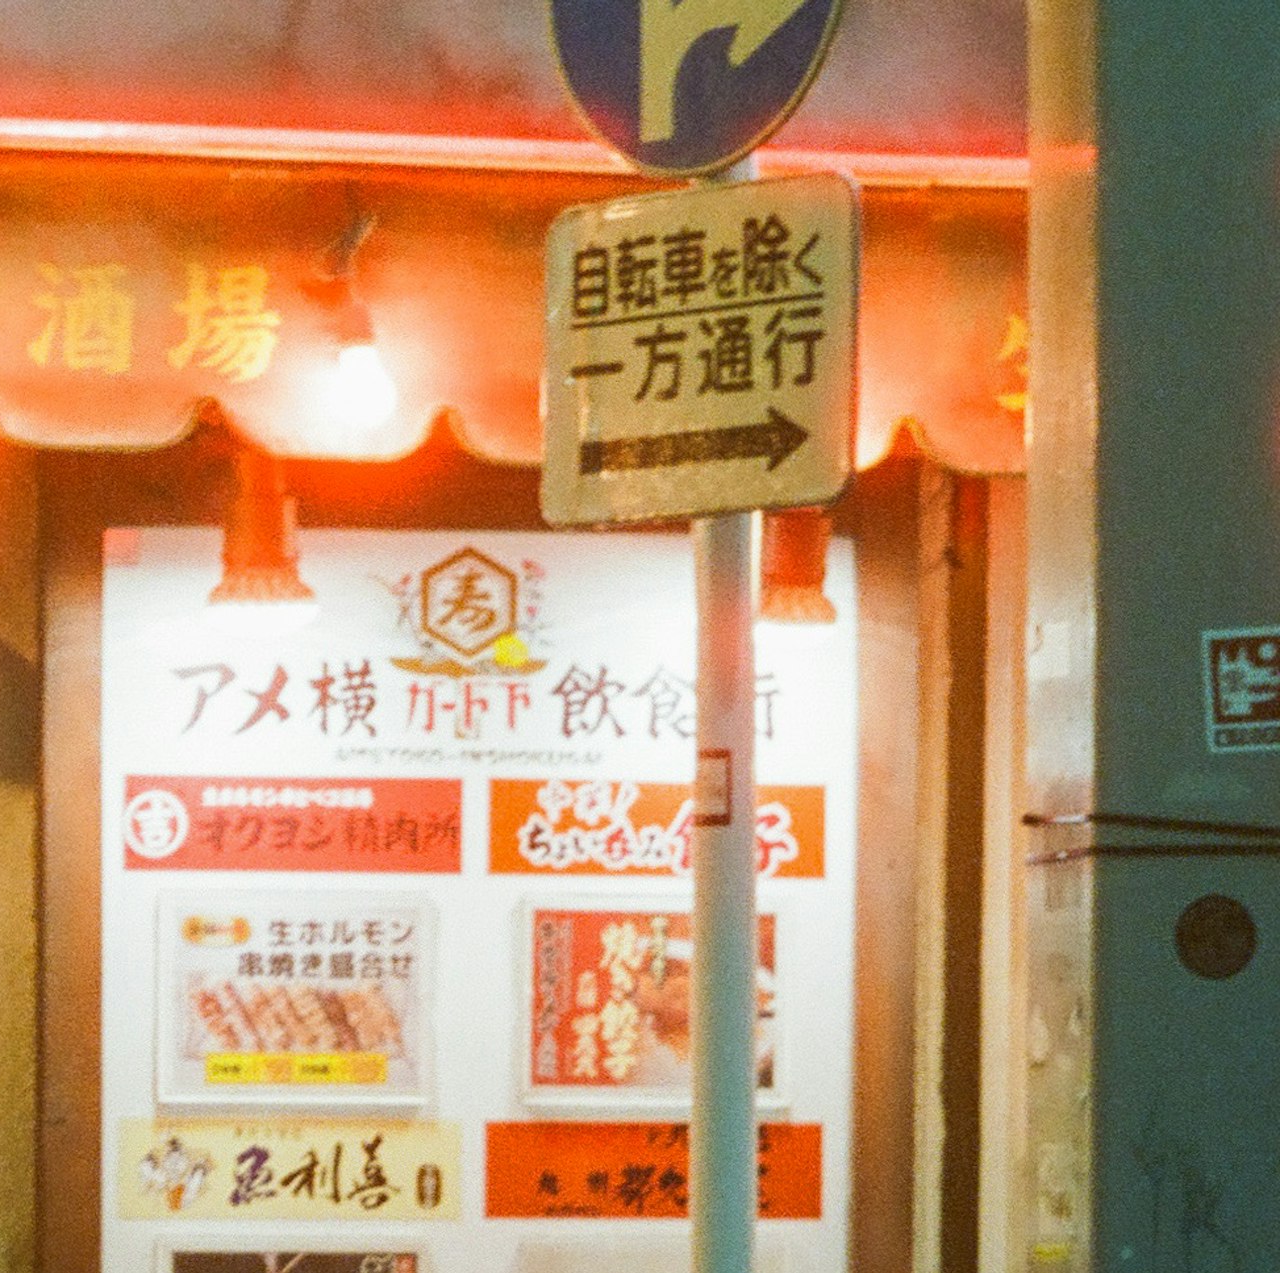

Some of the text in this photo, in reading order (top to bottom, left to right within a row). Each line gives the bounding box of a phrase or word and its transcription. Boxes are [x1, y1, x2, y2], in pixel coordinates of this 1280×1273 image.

[571, 214, 823, 317] 自転車を除く
[570, 306, 824, 402] 一方通行
[171, 660, 379, 740] アメ横
[268, 919, 416, 947] 生ホルモン
